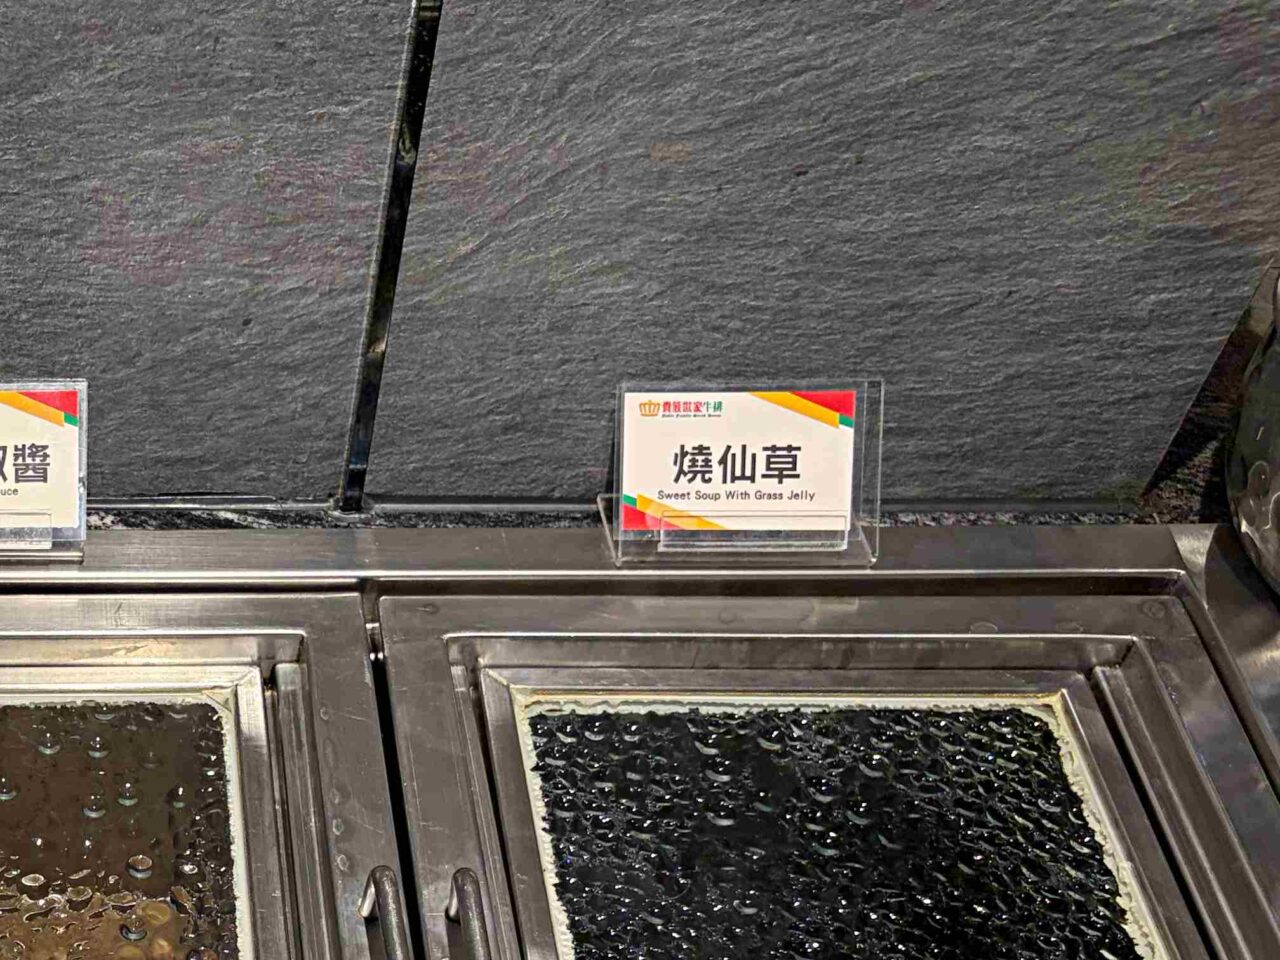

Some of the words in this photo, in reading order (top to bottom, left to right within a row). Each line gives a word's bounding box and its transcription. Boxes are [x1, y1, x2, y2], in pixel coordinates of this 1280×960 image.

[673, 444, 801, 484] 燒仙草
[657, 490, 691, 500] Sweet
[694, 490, 721, 501] Soup
[725, 490, 750, 500] With
[754, 490, 784, 500] Grass
[787, 490, 815, 501] Jelly
